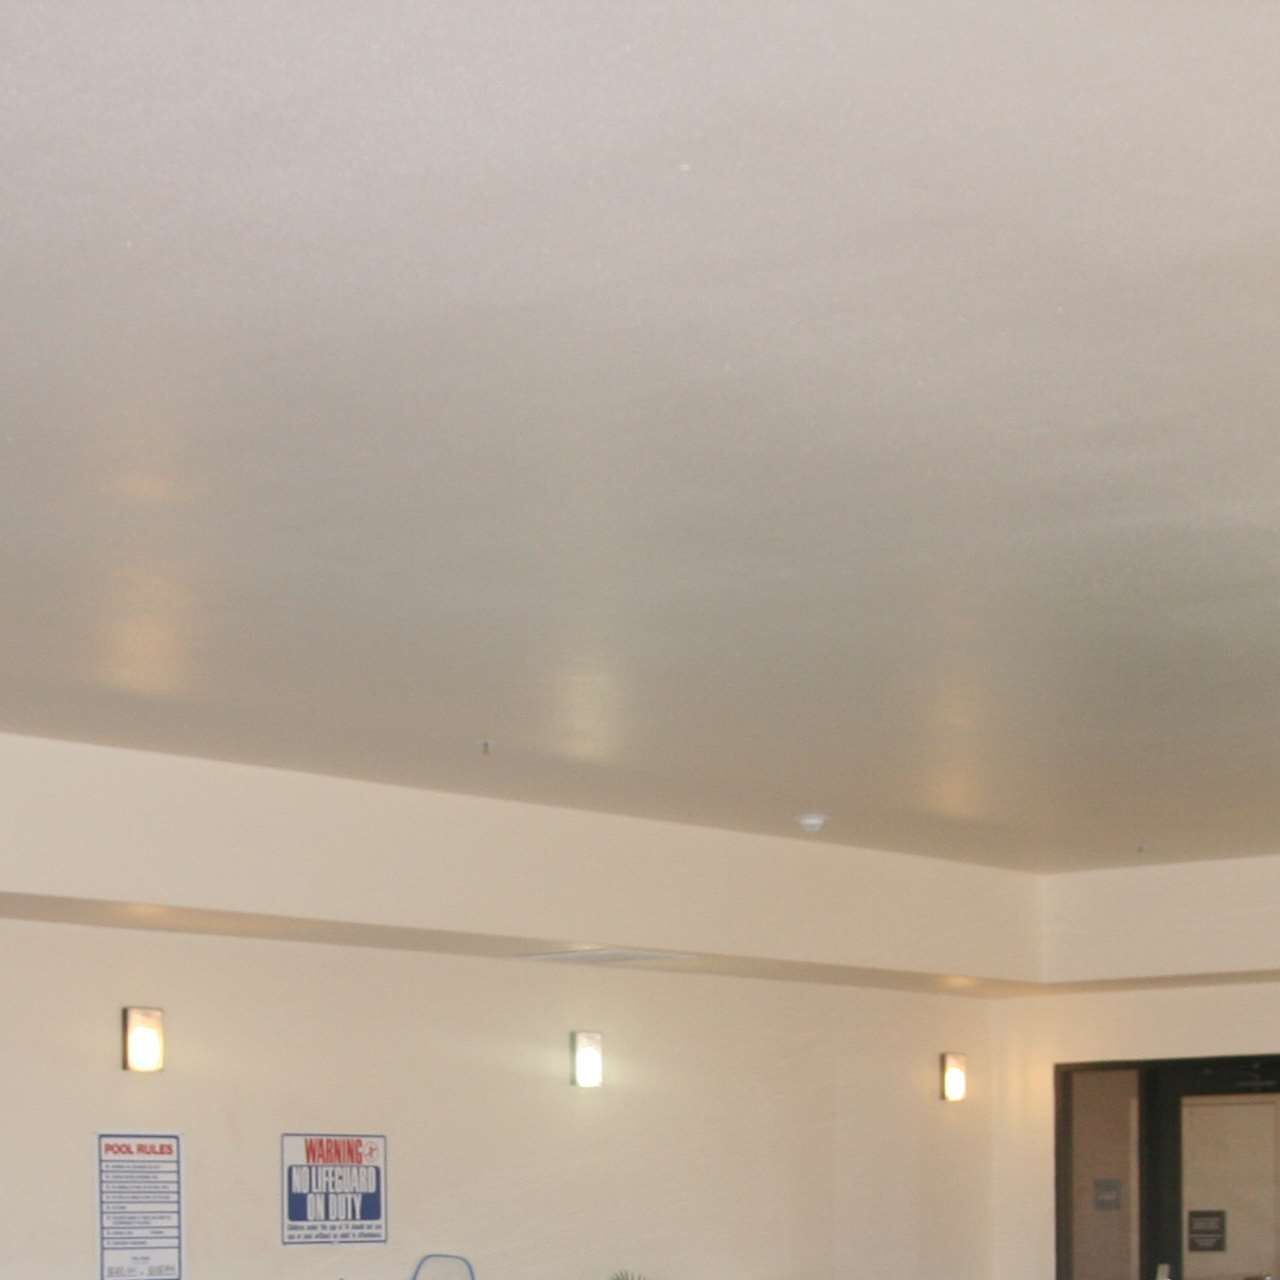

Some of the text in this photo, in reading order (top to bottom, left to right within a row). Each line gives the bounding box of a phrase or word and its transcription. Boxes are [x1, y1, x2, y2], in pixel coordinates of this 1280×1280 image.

[104, 1143, 173, 1155] POOL RULES
[304, 1136, 363, 1165] WARNING
[306, 1193, 362, 1220] ON DUTY
